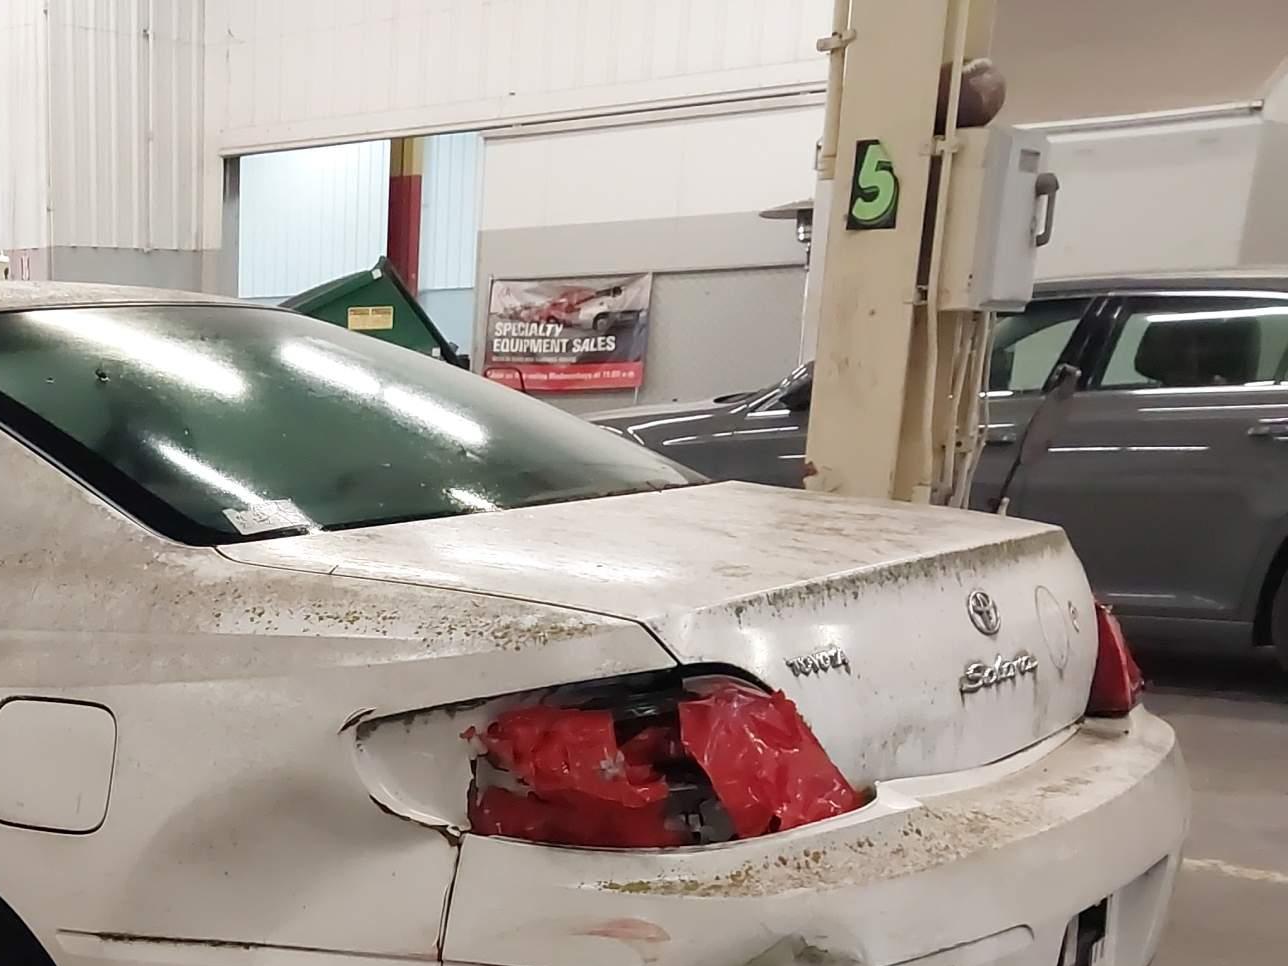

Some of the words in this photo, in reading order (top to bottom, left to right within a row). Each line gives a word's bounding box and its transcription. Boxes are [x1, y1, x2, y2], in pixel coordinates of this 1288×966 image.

[852, 144, 895, 220] 5
[495, 322, 563, 337] SPECIALTY
[493, 339, 569, 353] EQUIPMENT
[572, 336, 616, 352] SALES
[785, 648, 851, 677] TOYOTA
[960, 653, 1038, 694] Solara
